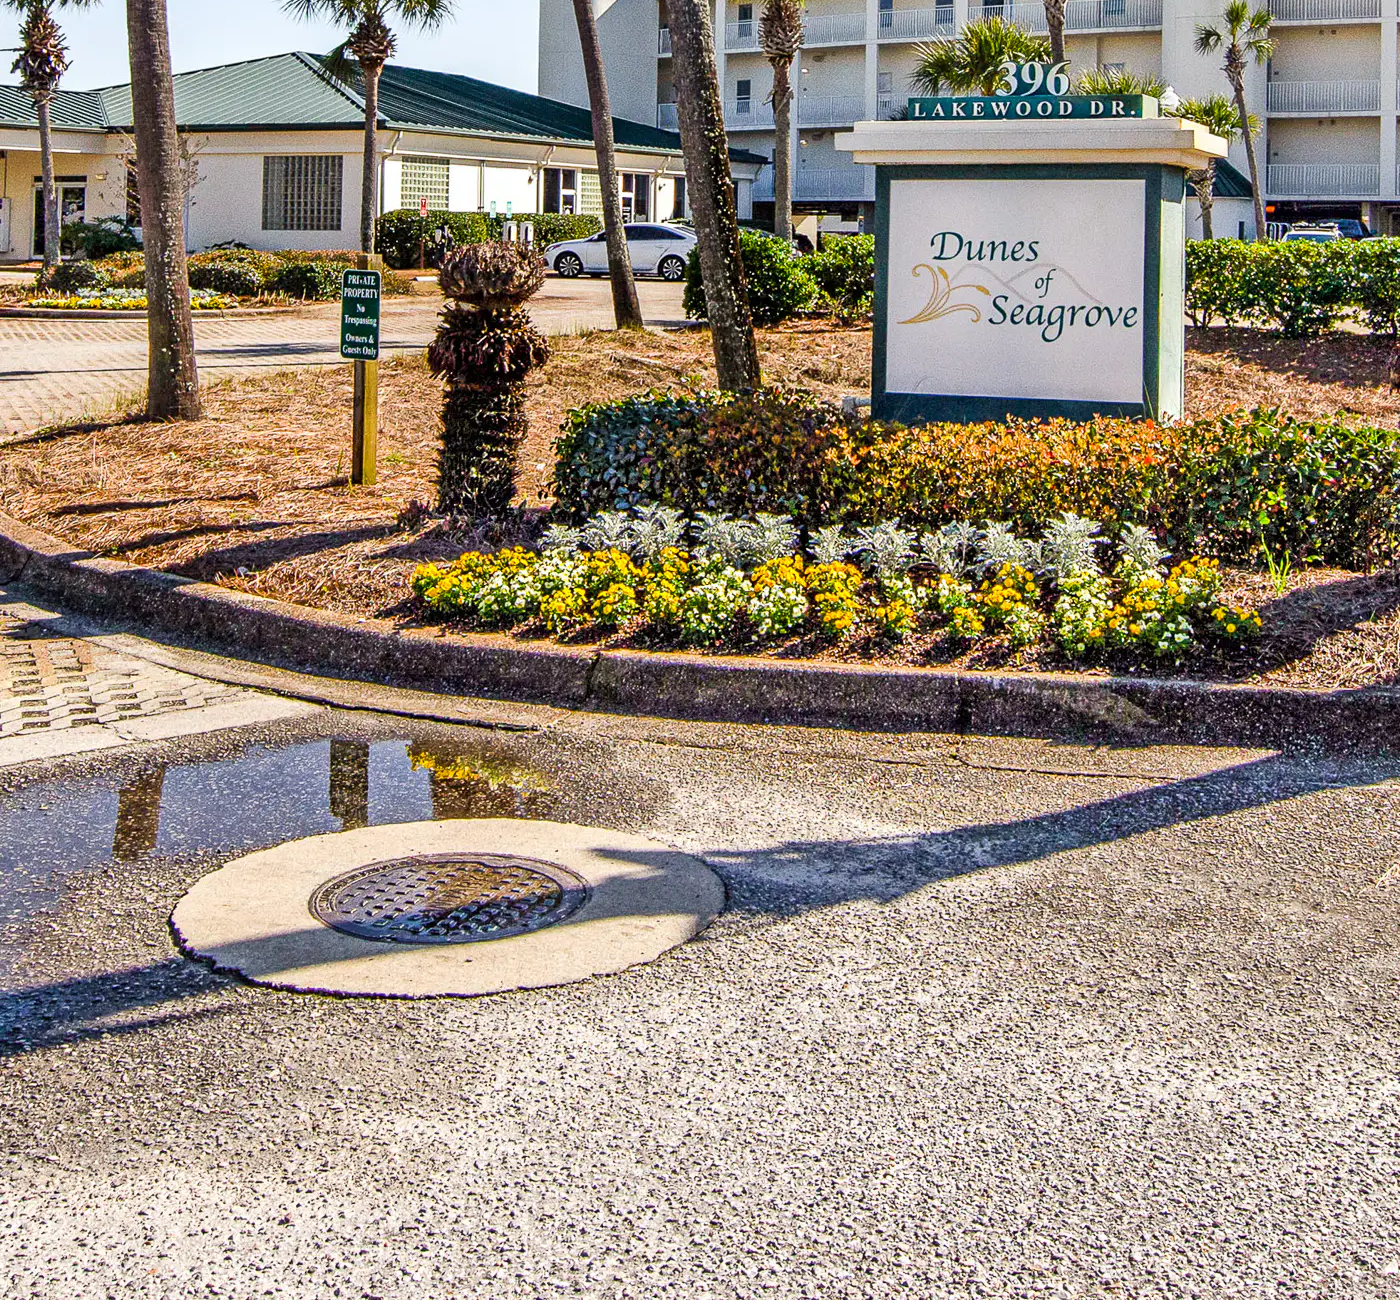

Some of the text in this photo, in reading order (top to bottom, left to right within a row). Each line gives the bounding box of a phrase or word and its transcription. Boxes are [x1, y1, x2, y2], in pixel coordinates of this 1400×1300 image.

[995, 60, 1071, 97] 396
[914, 100, 1136, 118] LAKEWOOD DR.
[930, 231, 1040, 262] Dunes
[1034, 269, 1057, 298] of
[343, 287, 379, 299] PROPERTY
[356, 303, 365, 312] No
[344, 315, 377, 327] Trespassing
[988, 295, 1138, 343] Seagrove
[345, 333, 374, 344] Owners &
[342, 345, 377, 358] Guests Only
